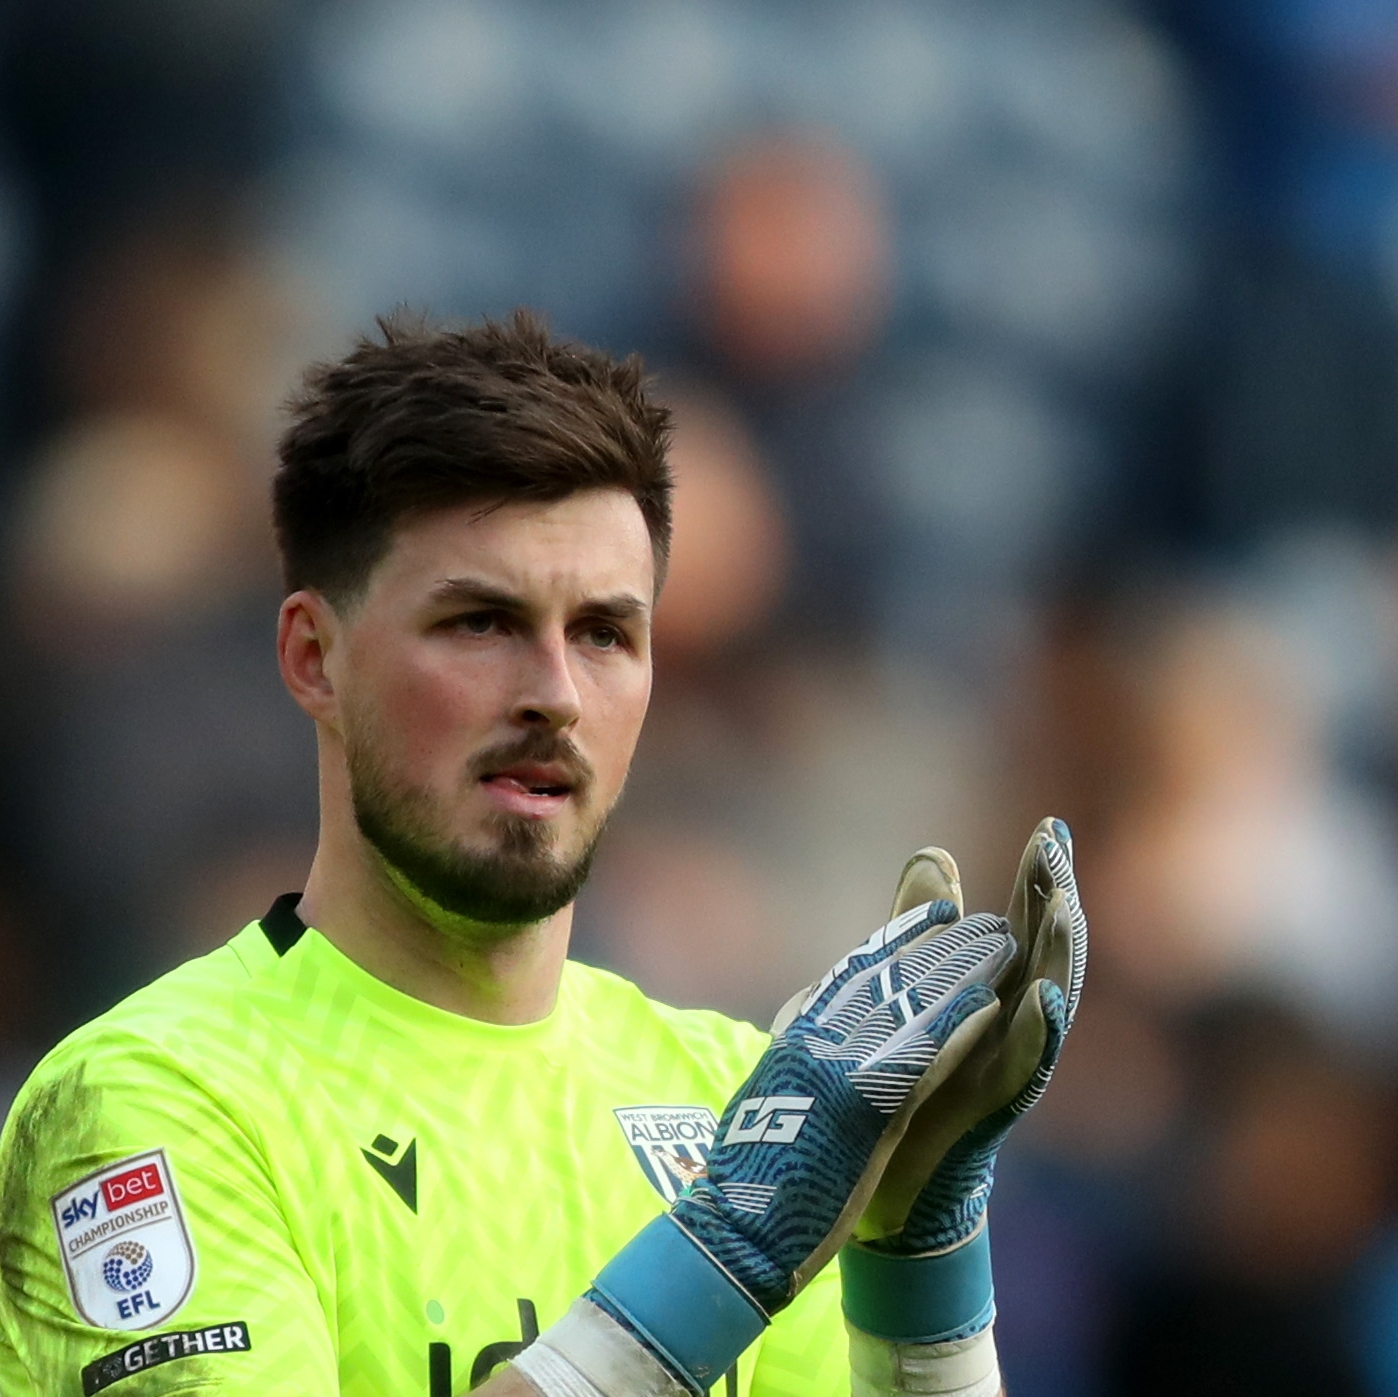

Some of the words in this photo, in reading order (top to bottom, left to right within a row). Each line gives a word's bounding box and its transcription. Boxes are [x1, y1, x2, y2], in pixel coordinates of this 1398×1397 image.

[621, 1112, 648, 1122] WEST
[652, 1111, 709, 1122] BROMWICH
[631, 1120, 716, 1142] ALBION
[61, 1189, 100, 1229] sky
[107, 1170, 156, 1203] bet
[68, 1200, 169, 1253] CHAMPIONSHIP
[116, 1289, 161, 1320] EFL
